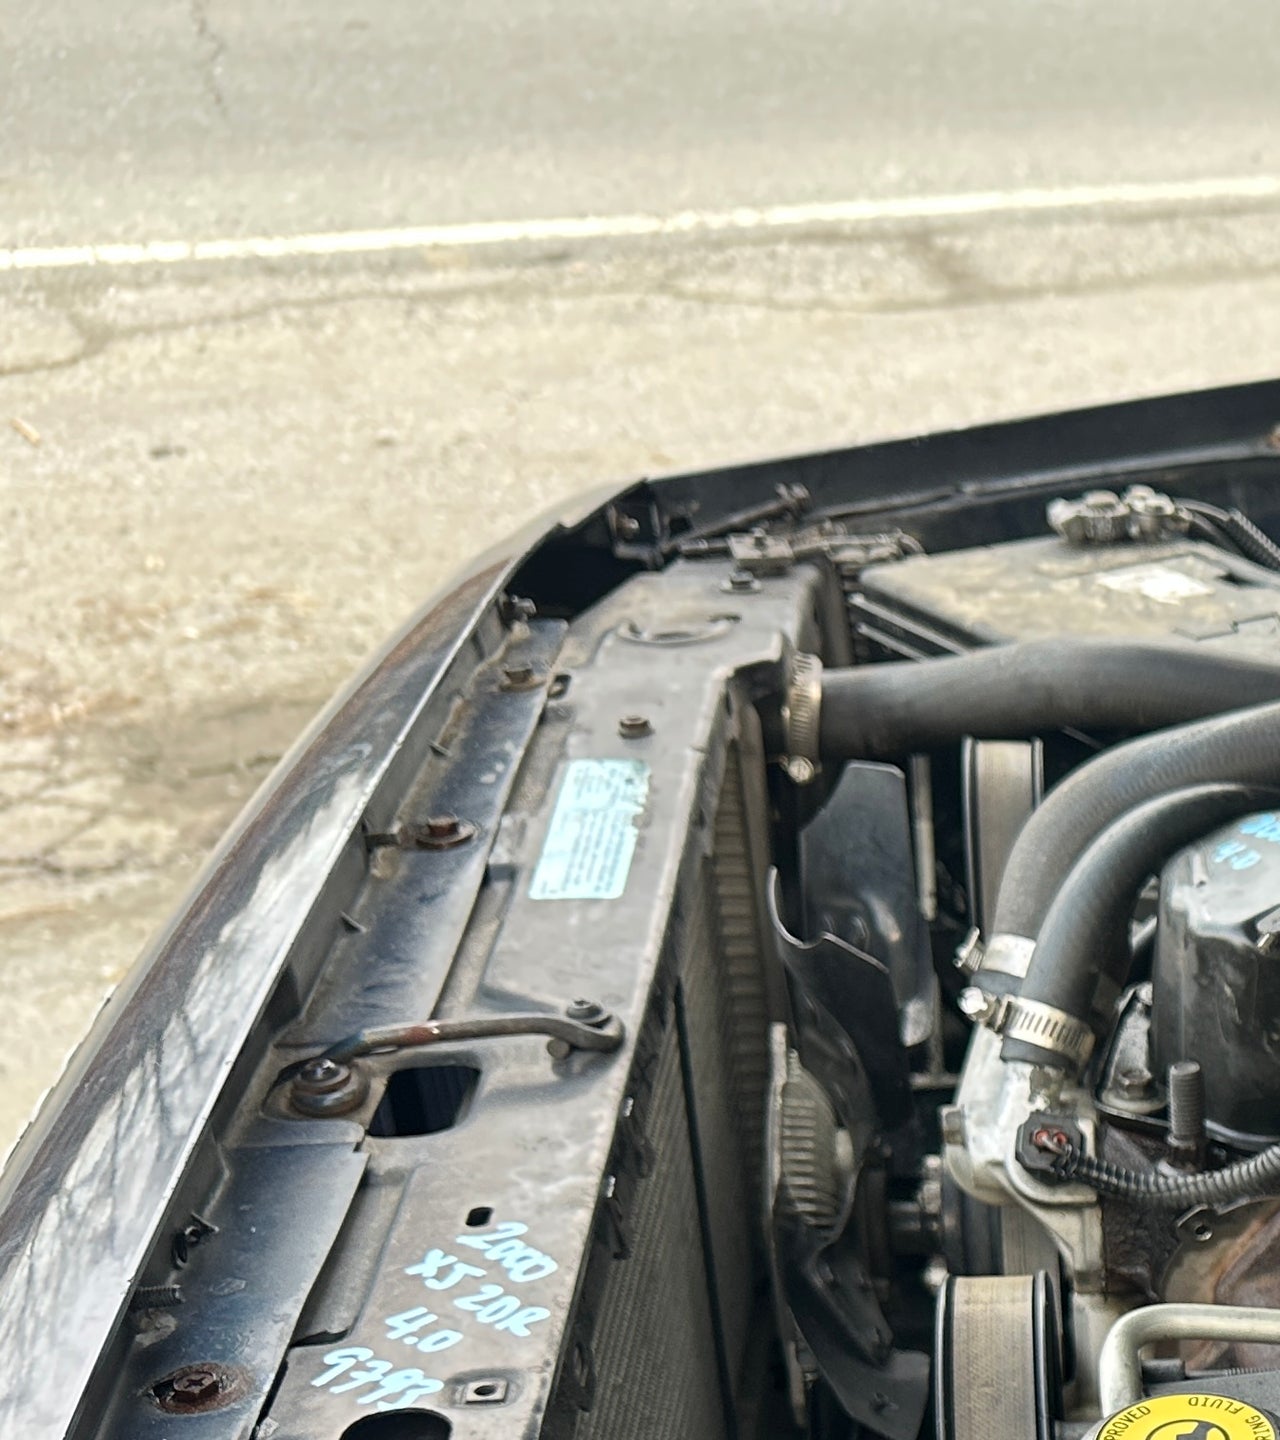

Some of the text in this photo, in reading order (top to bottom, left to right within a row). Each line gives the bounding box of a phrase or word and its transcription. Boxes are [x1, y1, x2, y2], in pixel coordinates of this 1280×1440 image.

[455, 1221, 559, 1283] 2000
[385, 1307, 464, 1352] 4.0
[1188, 1396, 1245, 1415] FLUID
